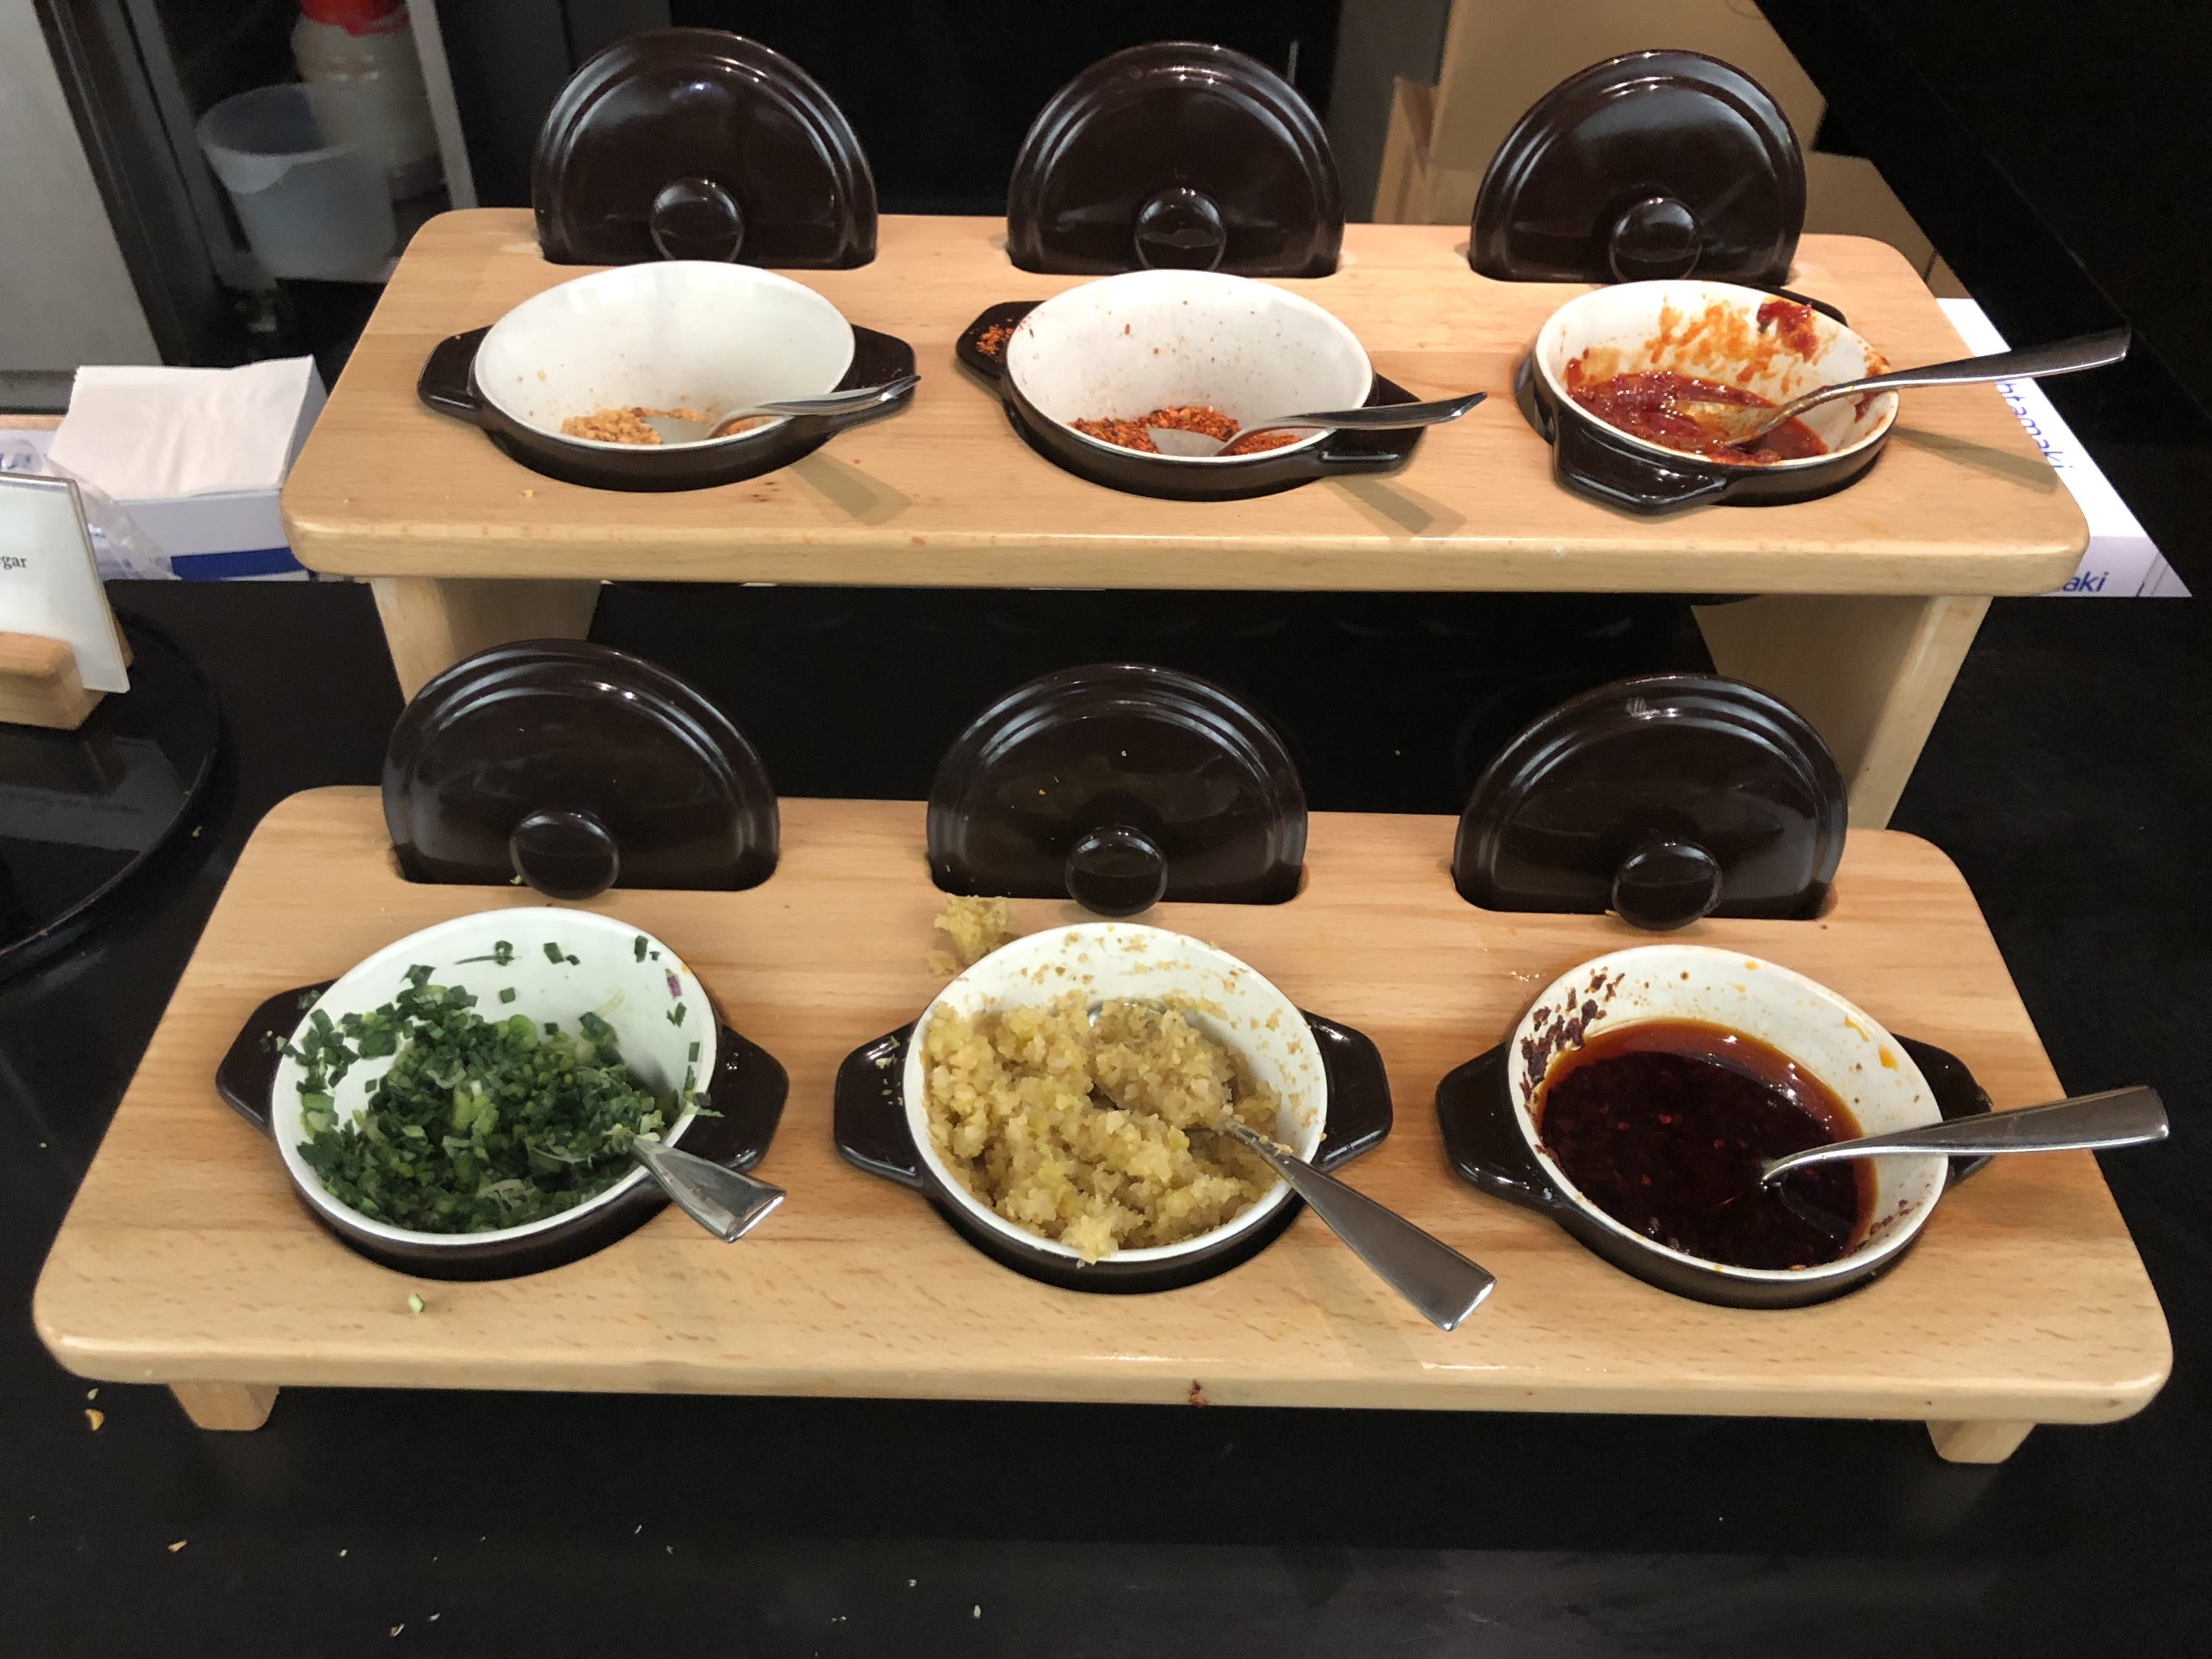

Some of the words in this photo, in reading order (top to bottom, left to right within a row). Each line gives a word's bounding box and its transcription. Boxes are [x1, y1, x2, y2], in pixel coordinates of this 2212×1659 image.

[1994, 382, 2073, 469] htamaki
[0, 556, 27, 570] gar
[2063, 571, 2109, 592] aki
